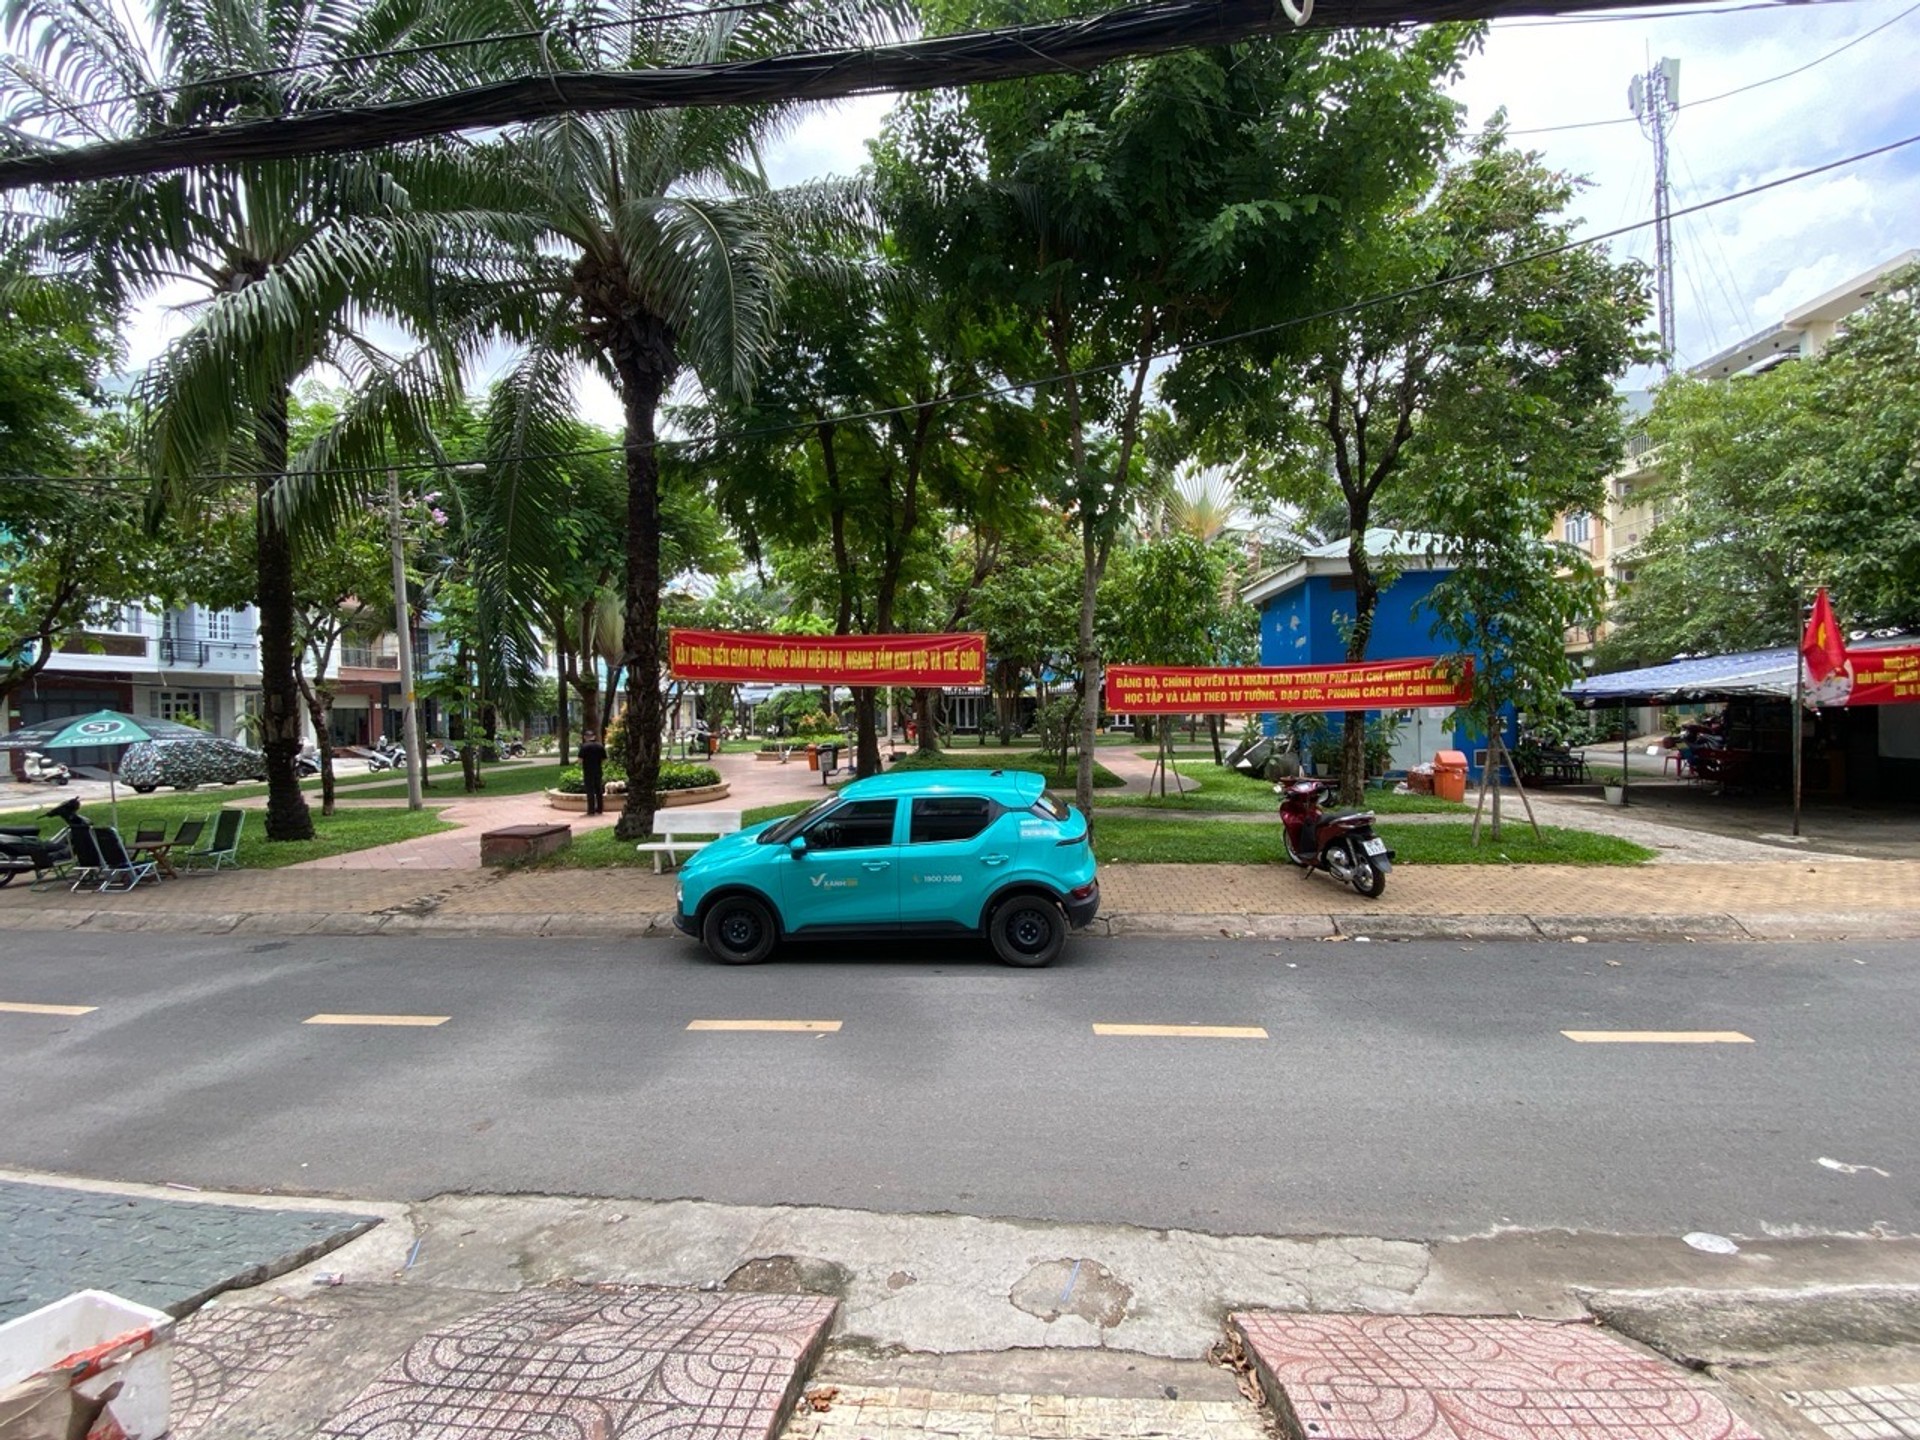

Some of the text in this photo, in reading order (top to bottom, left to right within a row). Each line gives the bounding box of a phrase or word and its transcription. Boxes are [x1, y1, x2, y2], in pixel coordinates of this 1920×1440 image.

[1116, 674, 1142, 688] ĐẢNG
[1144, 675, 1160, 689] BỘ,
[1162, 675, 1191, 687] CHÍNH
[1194, 673, 1225, 687] QUYỀN
[1227, 674, 1240, 686] VÀ
[1243, 673, 1270, 686] NHÂN
[1272, 672, 1293, 685] DÂN
[1295, 672, 1327, 684] THÀNH
[1329, 670, 1348, 684] PHỐ
[1351, 668, 1364, 683] HỒ
[1366, 669, 1383, 682] CHÍ
[1385, 669, 1411, 681] MINH
[1124, 683, 1455, 705] HỌC TẬP VÀ LÀM THEO TƯ TƯỞNG, ĐẠO ĐỨC, PHONG CÁCH HỒ CHÍ MINH!
